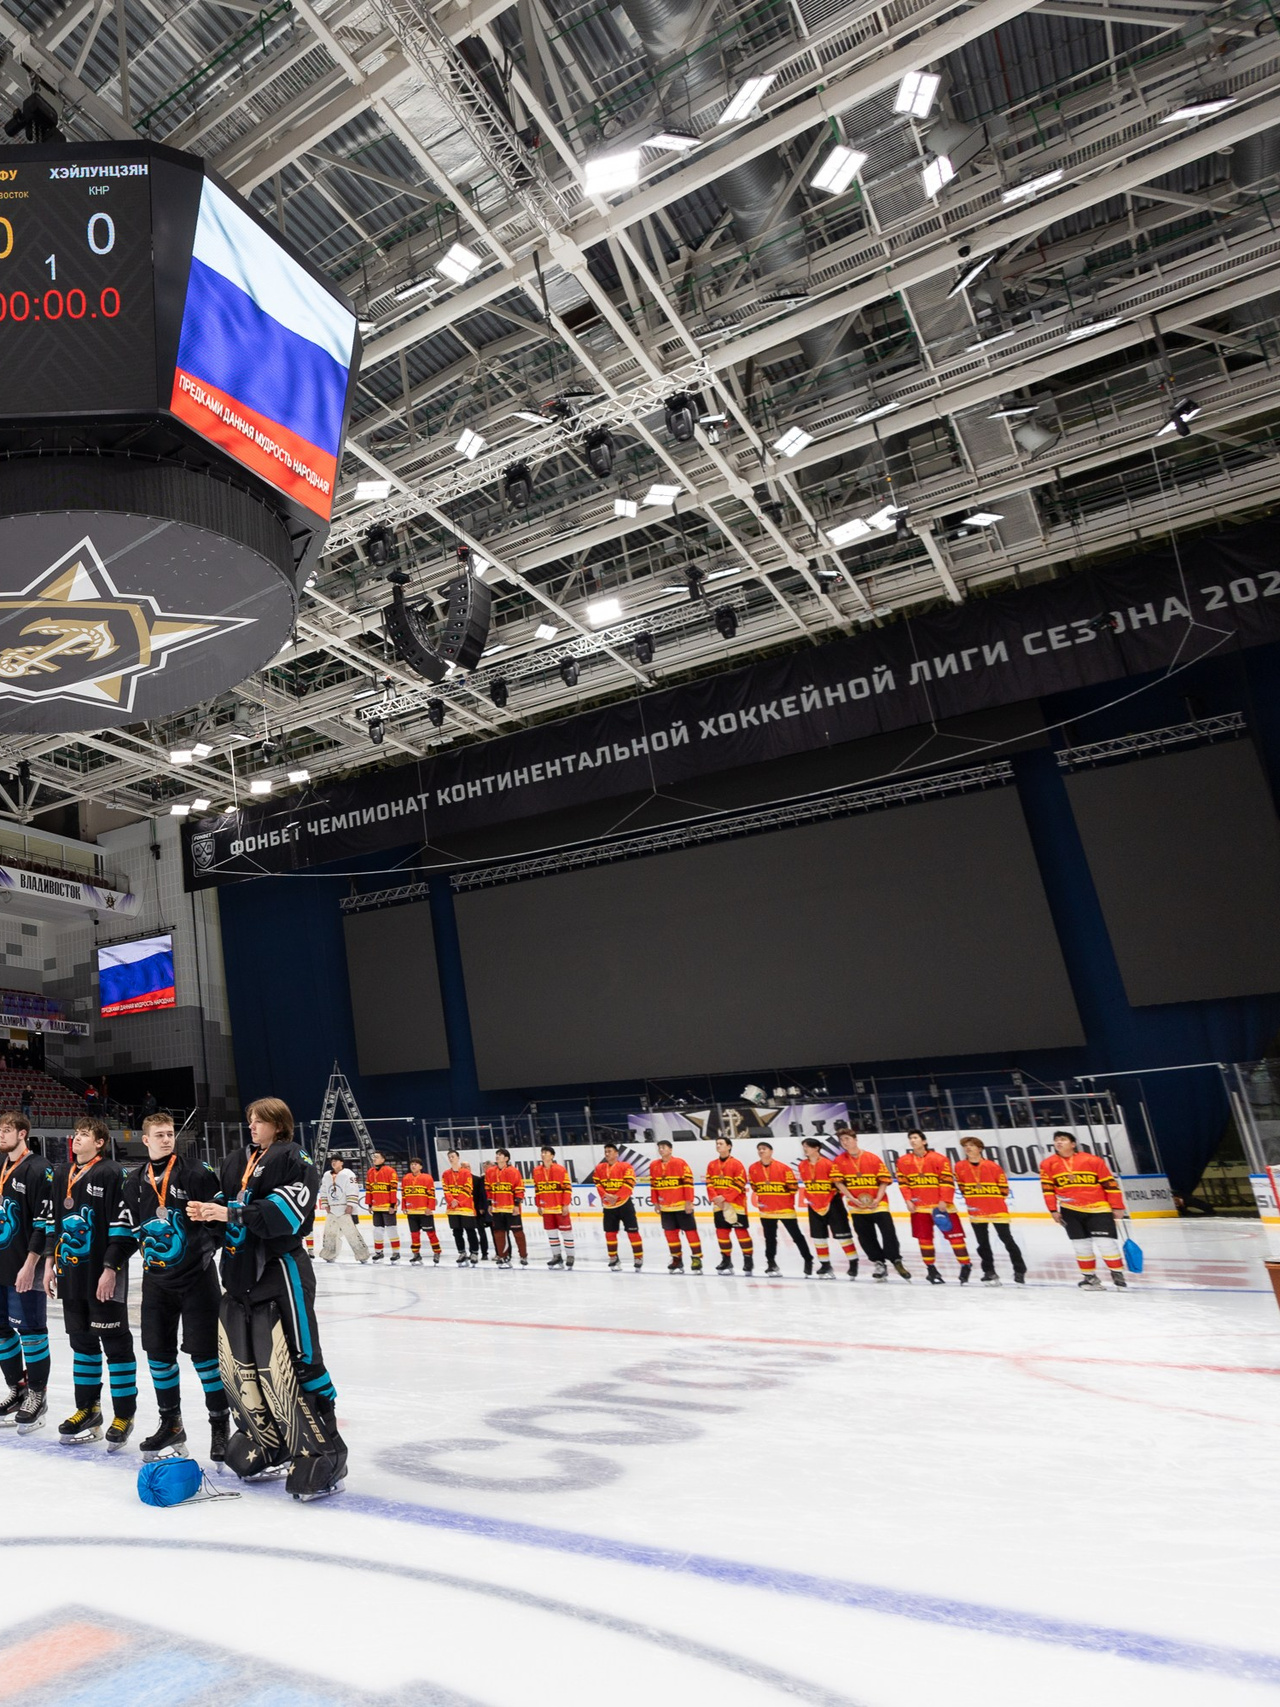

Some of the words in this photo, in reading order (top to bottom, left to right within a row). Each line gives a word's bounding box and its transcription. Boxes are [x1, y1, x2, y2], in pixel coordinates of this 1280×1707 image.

[49, 164, 149, 180] ХЭЙЛУНЦЗЯН
[88, 186, 110, 195] КНР
[87, 212, 116, 255] 0
[44, 253, 56, 280] 1
[179, 374, 224, 418] ПРЕДКАМИ
[222, 408, 255, 440] ДАННАЯ
[254, 430, 293, 468] МУДРОСТЬ
[292, 459, 330, 495] НАРОДНАЯ!
[230, 826, 301, 856] ФОНБЕТ
[307, 793, 429, 836] ЧЕМПИОНАТ
[437, 720, 689, 806] КОНТИНЕНТАЛЬНОЙ
[699, 664, 896, 740] ХОККЕЙНОЙ
[908, 641, 1009, 685] ЛИГИ
[20, 873, 81, 901] ВЛАДИВОСТОК
[756, 1185, 786, 1193] CHINA
[910, 1176, 939, 1185] CHINA
[1056, 1174, 1096, 1186] CHINA
[290, 1181, 312, 1206] 20
[964, 1186, 1002, 1195] CHINA
[91, 1321, 120, 1329] BAUER
[297, 1396, 326, 1444] BAUER
